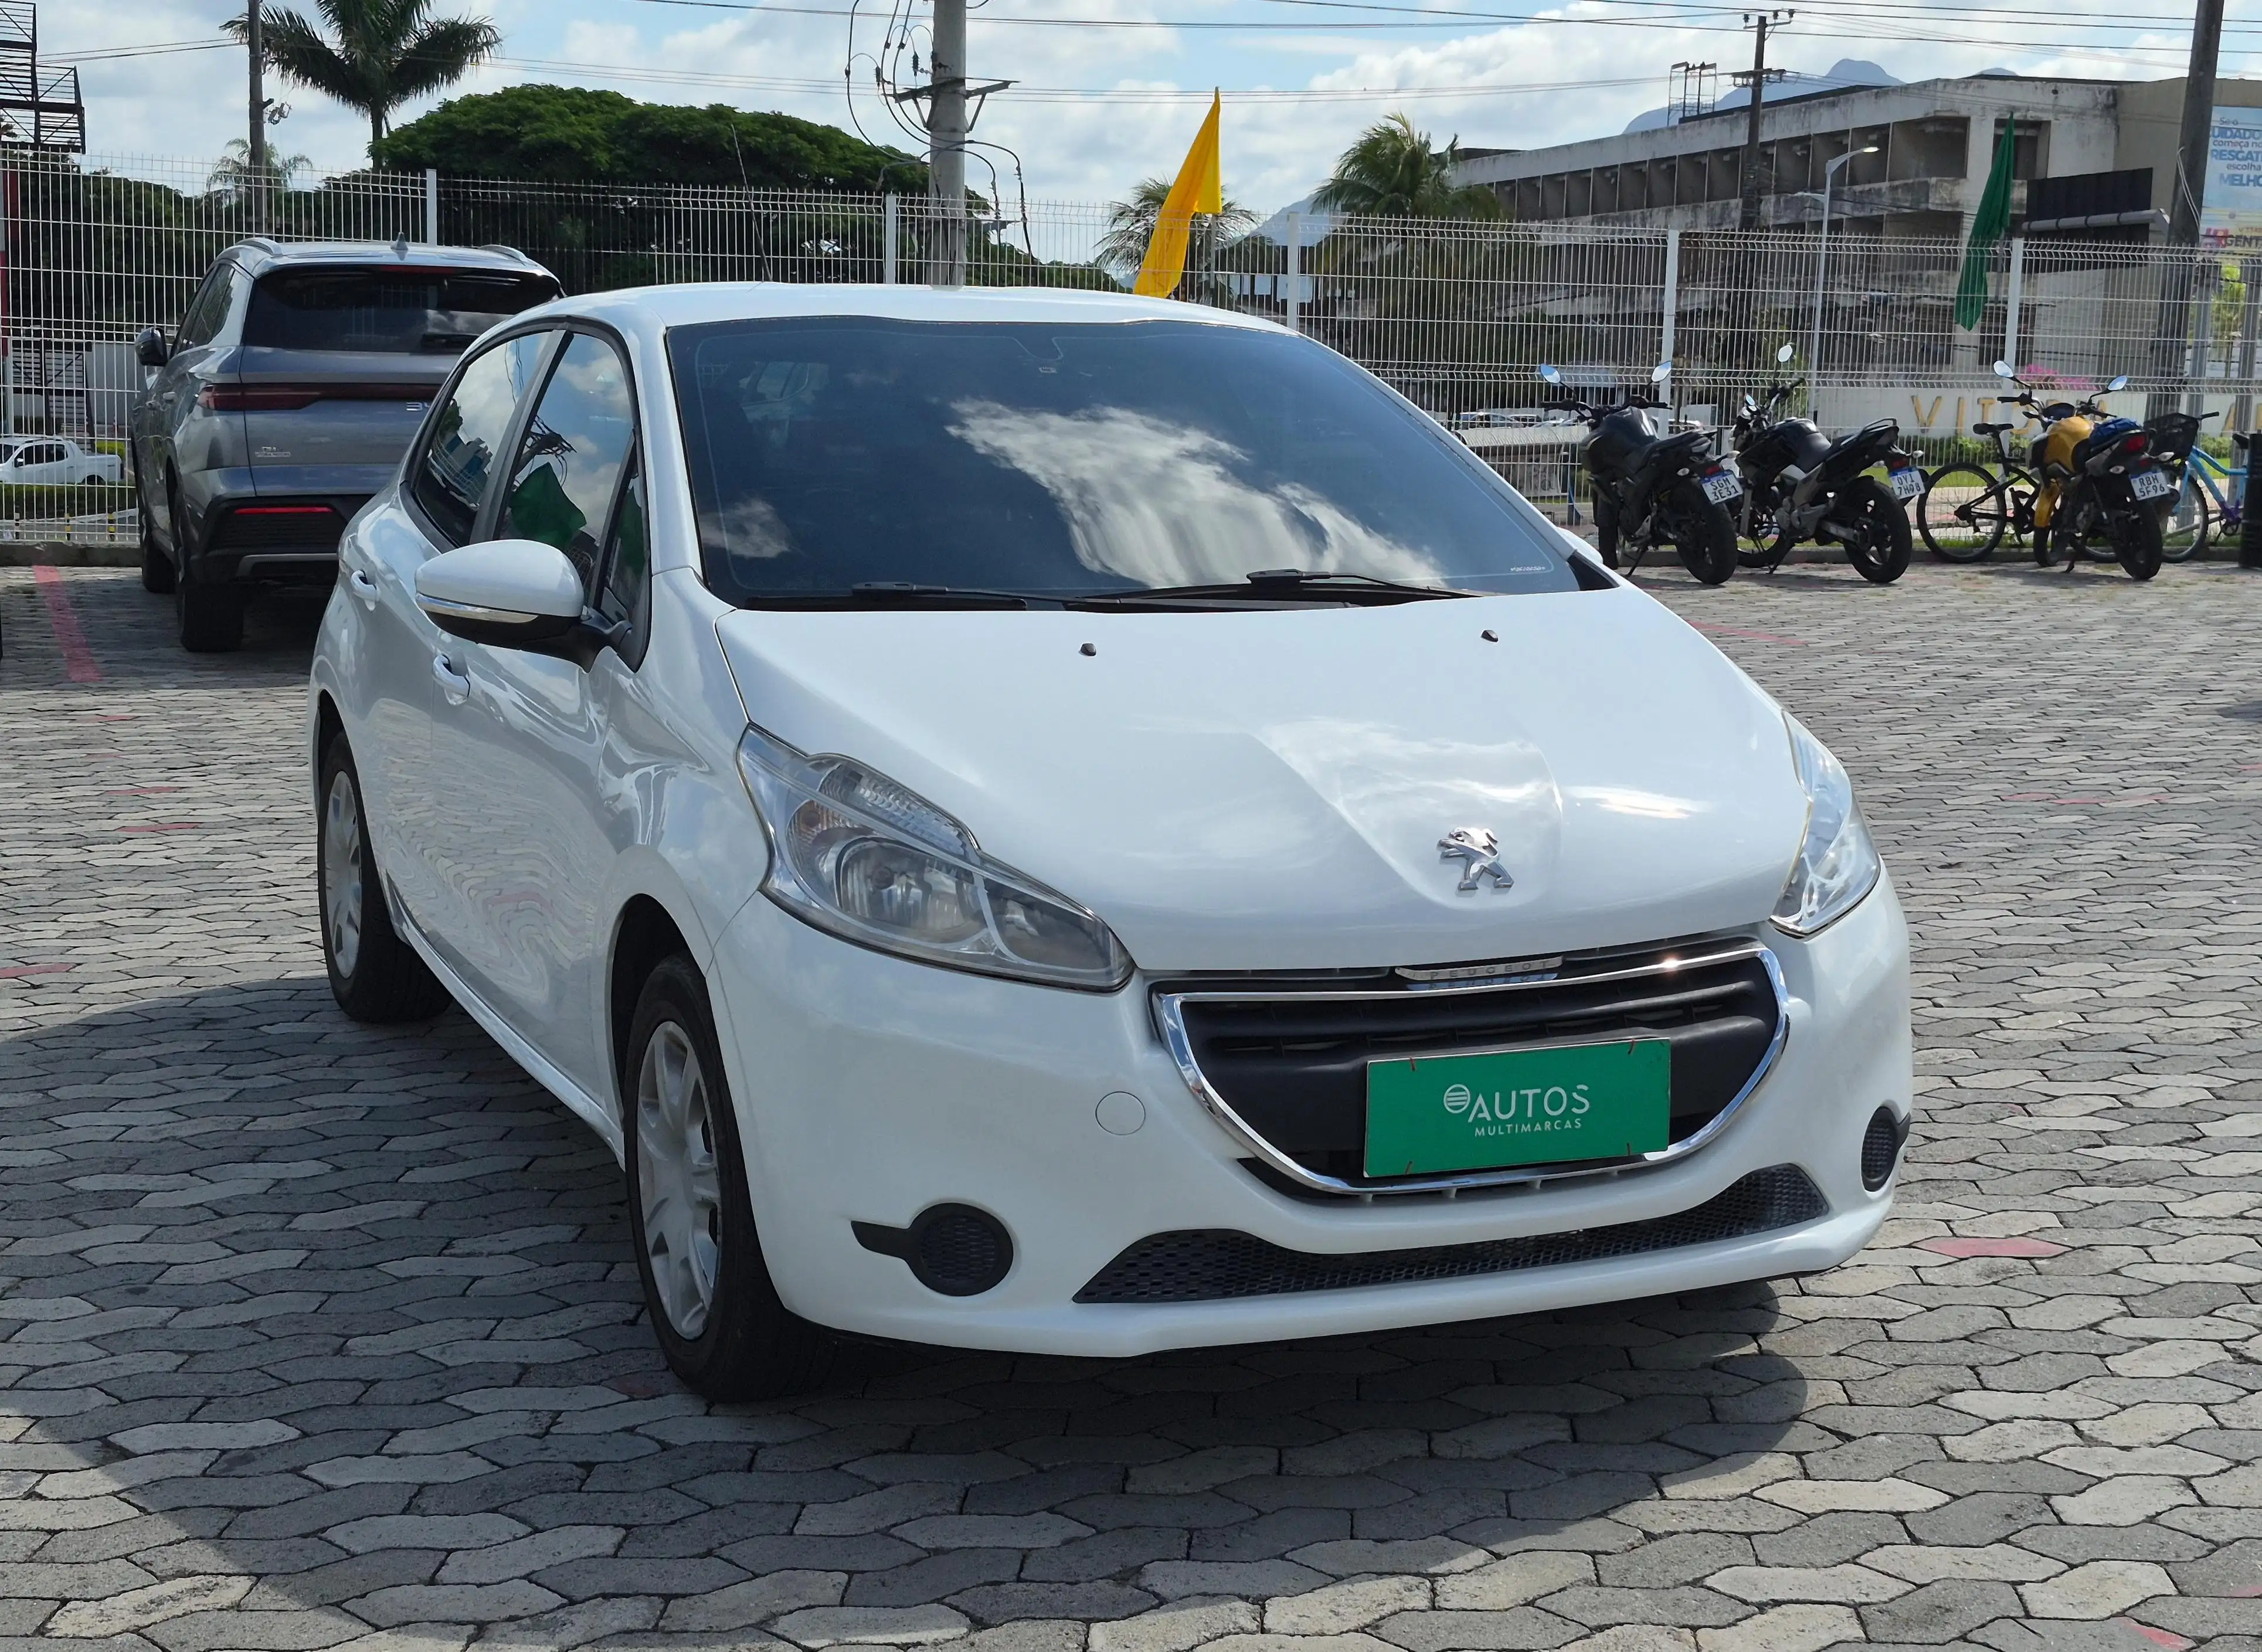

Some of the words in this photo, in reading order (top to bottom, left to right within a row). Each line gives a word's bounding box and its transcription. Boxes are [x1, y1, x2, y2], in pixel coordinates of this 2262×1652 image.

[2212, 127, 2261, 140] UIDADO
[2211, 149, 2262, 161] RESGAT
[2226, 162, 2261, 171] escolha
[2139, 475, 2159, 487] RBH
[1712, 485, 1739, 500] 3E31
[2139, 483, 2165, 497] 5F96
[1430, 961, 1549, 978] PEUGEOT
[1468, 1085, 1589, 1122] AUTOS
[1475, 1118, 1582, 1137] MULTIMARCAS
